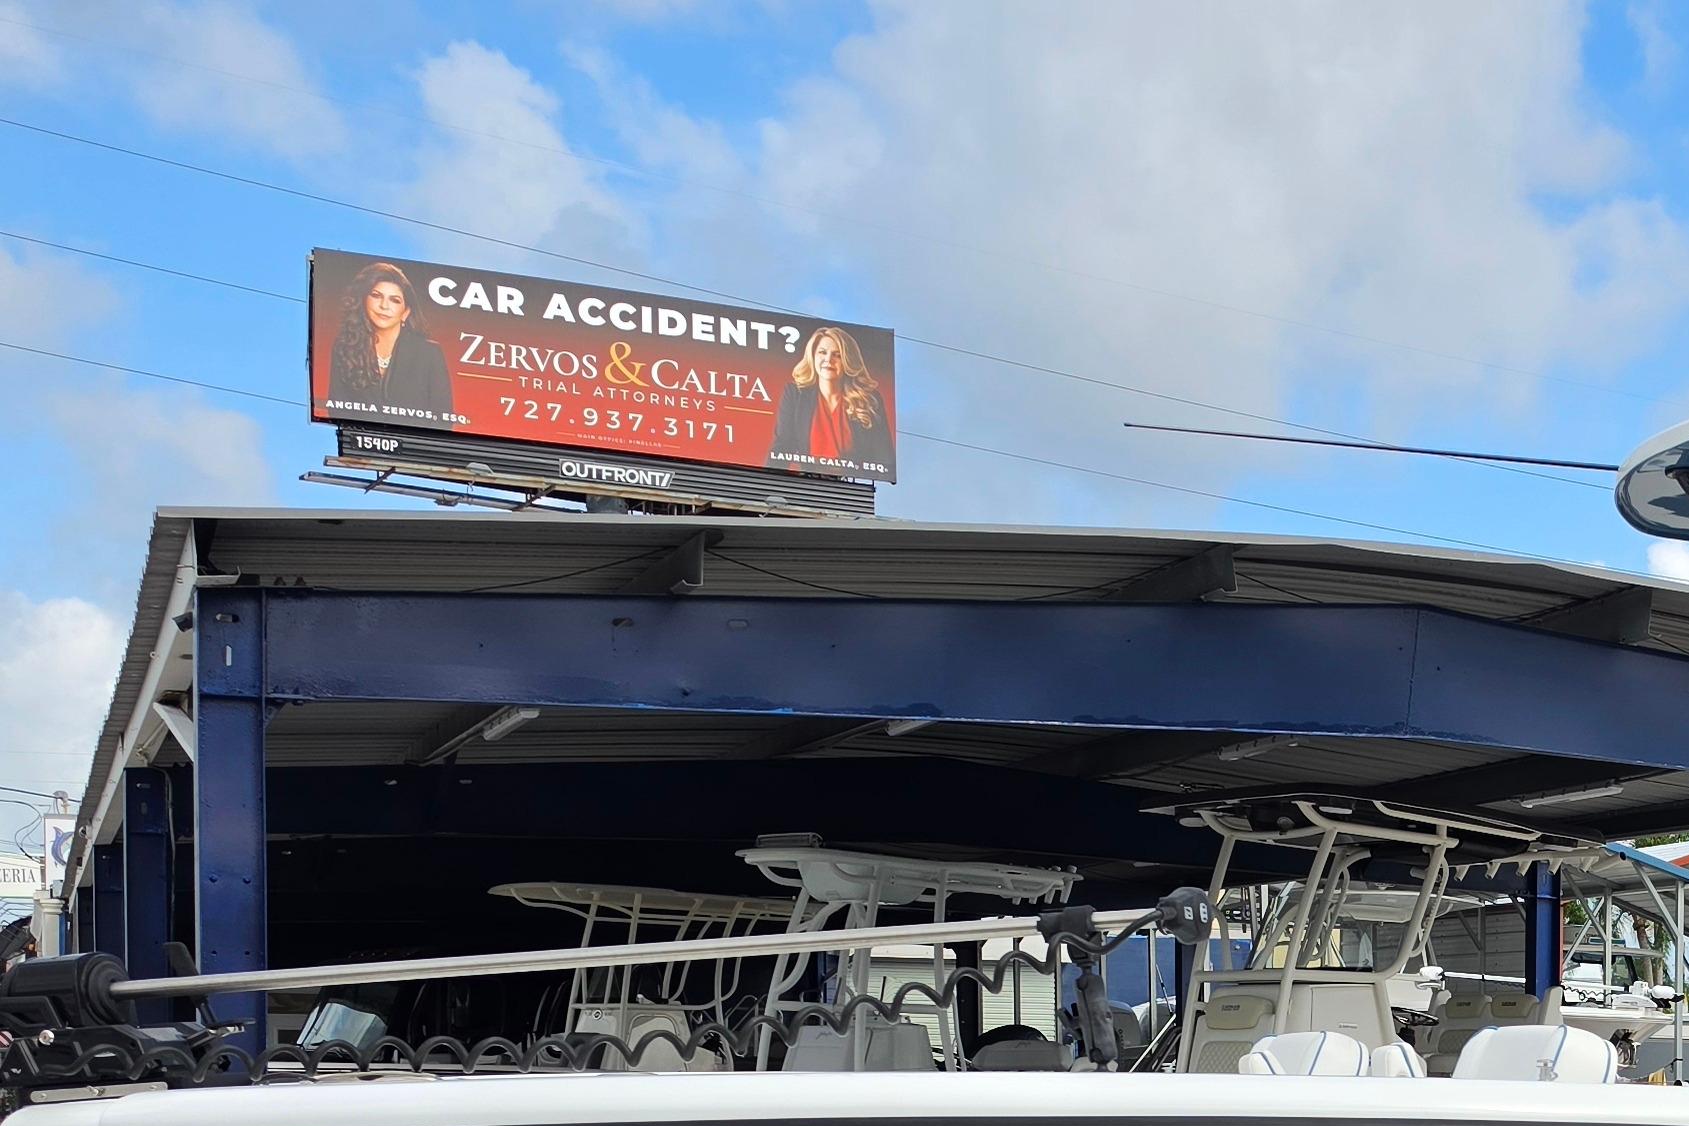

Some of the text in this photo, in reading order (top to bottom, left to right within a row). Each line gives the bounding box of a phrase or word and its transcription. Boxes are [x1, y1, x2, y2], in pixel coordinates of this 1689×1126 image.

[429, 277, 801, 354] CAR ACCIDENT?
[459, 331, 773, 403] ZERVOS & CALTA
[325, 400, 378, 413] ANGELA
[442, 412, 471, 425] ESQ.
[518, 375, 716, 413] TRIAL ATTORNEYS
[499, 396, 736, 444] 727.937.3171
[770, 452, 815, 464] LAUREN
[863, 462, 889, 473] ESQ.
[0, 868, 36, 883] ERIA
